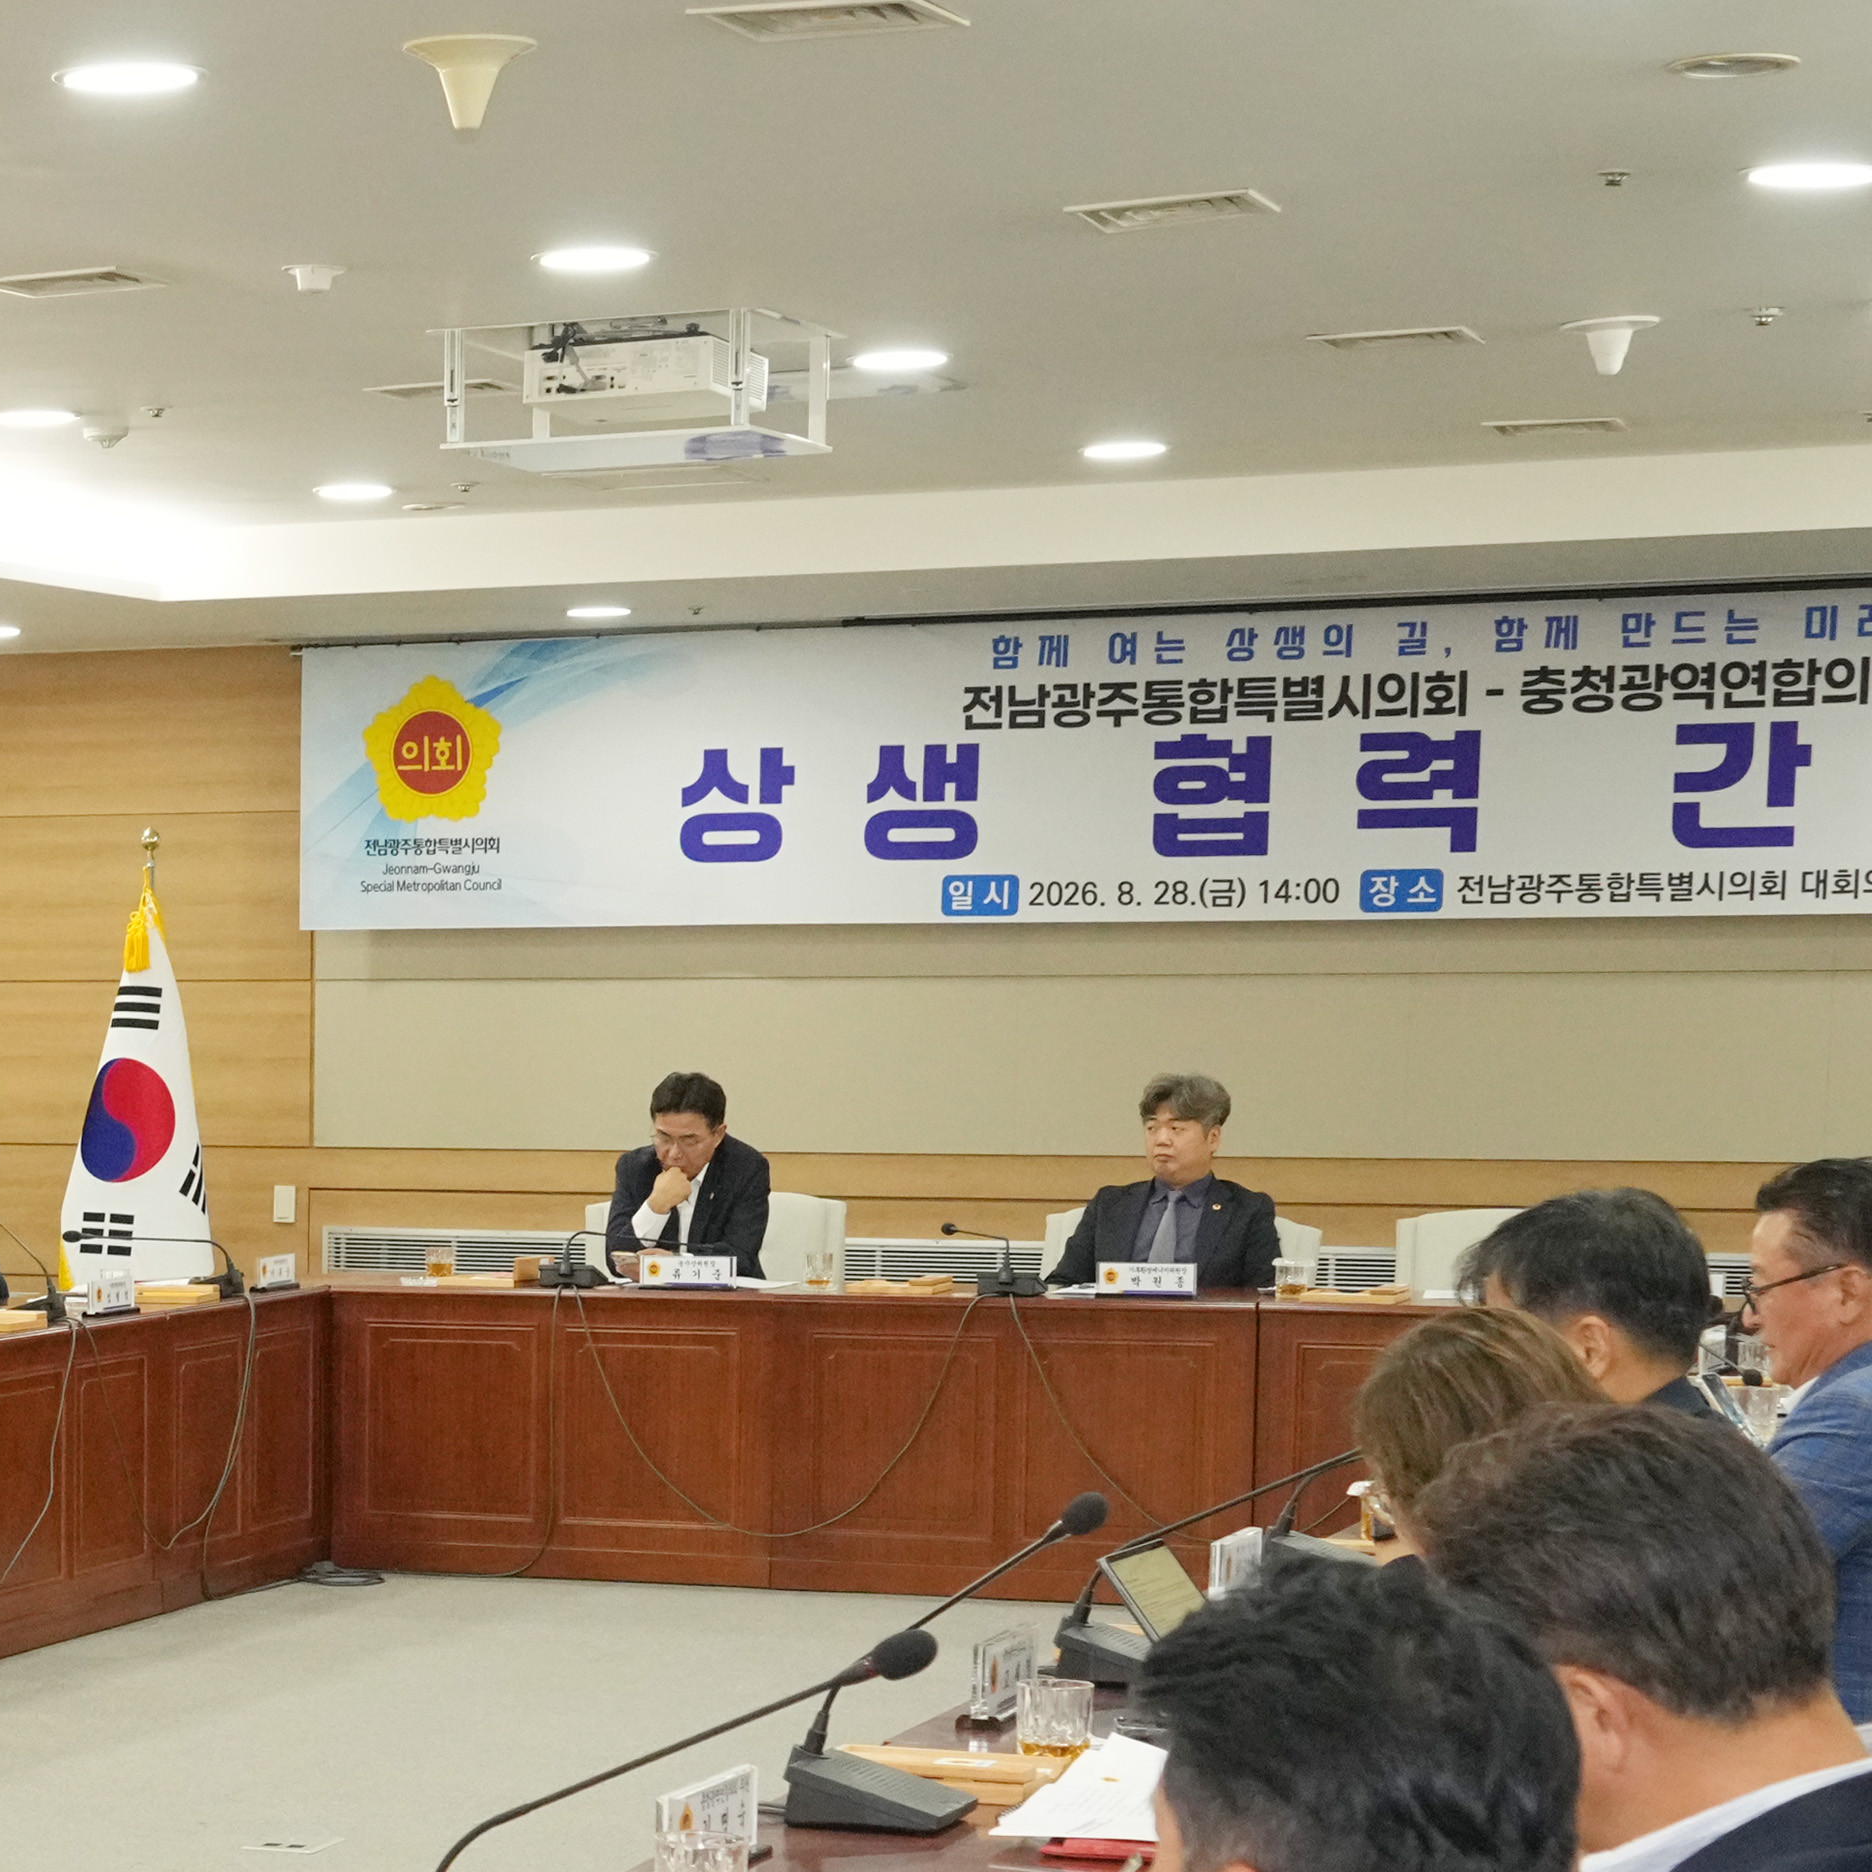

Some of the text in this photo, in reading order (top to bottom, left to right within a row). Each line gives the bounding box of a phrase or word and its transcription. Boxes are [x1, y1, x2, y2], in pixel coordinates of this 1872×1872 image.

[991, 632, 1070, 670] 함께
[1107, 630, 1186, 666] 여는
[1224, 623, 1355, 663] 상생의
[1396, 620, 1453, 659] 길,
[1493, 613, 1580, 653] 함께
[1620, 608, 1760, 648] 만드는
[962, 656, 1871, 731] 전남광주통합특별시의회 - 충청광역연합의
[396, 734, 464, 774] 의회
[679, 721, 1813, 863] 상생 협력 간
[363, 836, 501, 857] 전남광주통합특별시의회
[359, 876, 503, 894] Special Metropolitan Council
[381, 861, 481, 878] Jeonnam-Gwangju
[1028, 881, 1107, 909] 2026.
[1117, 881, 1143, 908] 8.
[1154, 878, 1247, 910] 28.(금)
[1259, 878, 1340, 905] 14:00
[1456, 869, 1788, 904] 전남광주통합특별시의회
